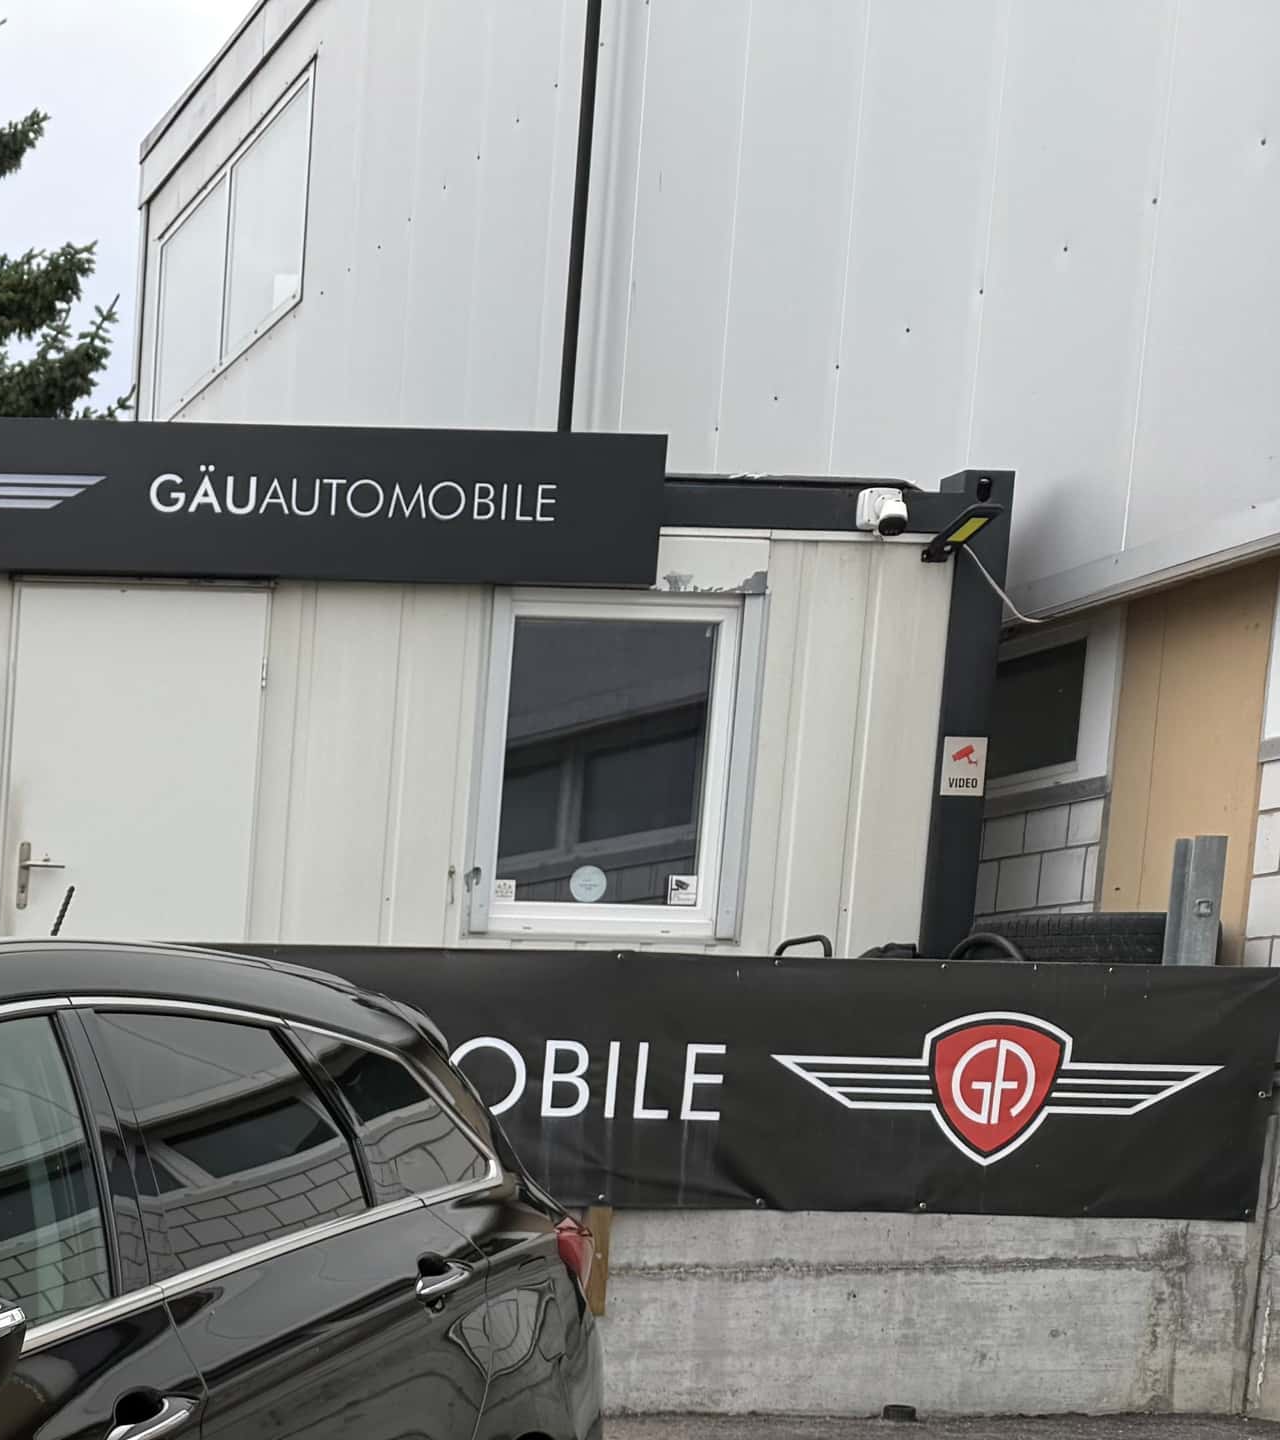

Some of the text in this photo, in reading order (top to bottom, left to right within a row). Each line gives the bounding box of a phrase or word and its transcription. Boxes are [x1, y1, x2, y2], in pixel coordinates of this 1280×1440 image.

[149, 464, 558, 521] GÄUAUTOMOBILE
[947, 776, 978, 789] VIDEO
[447, 1035, 728, 1121] OBILE
